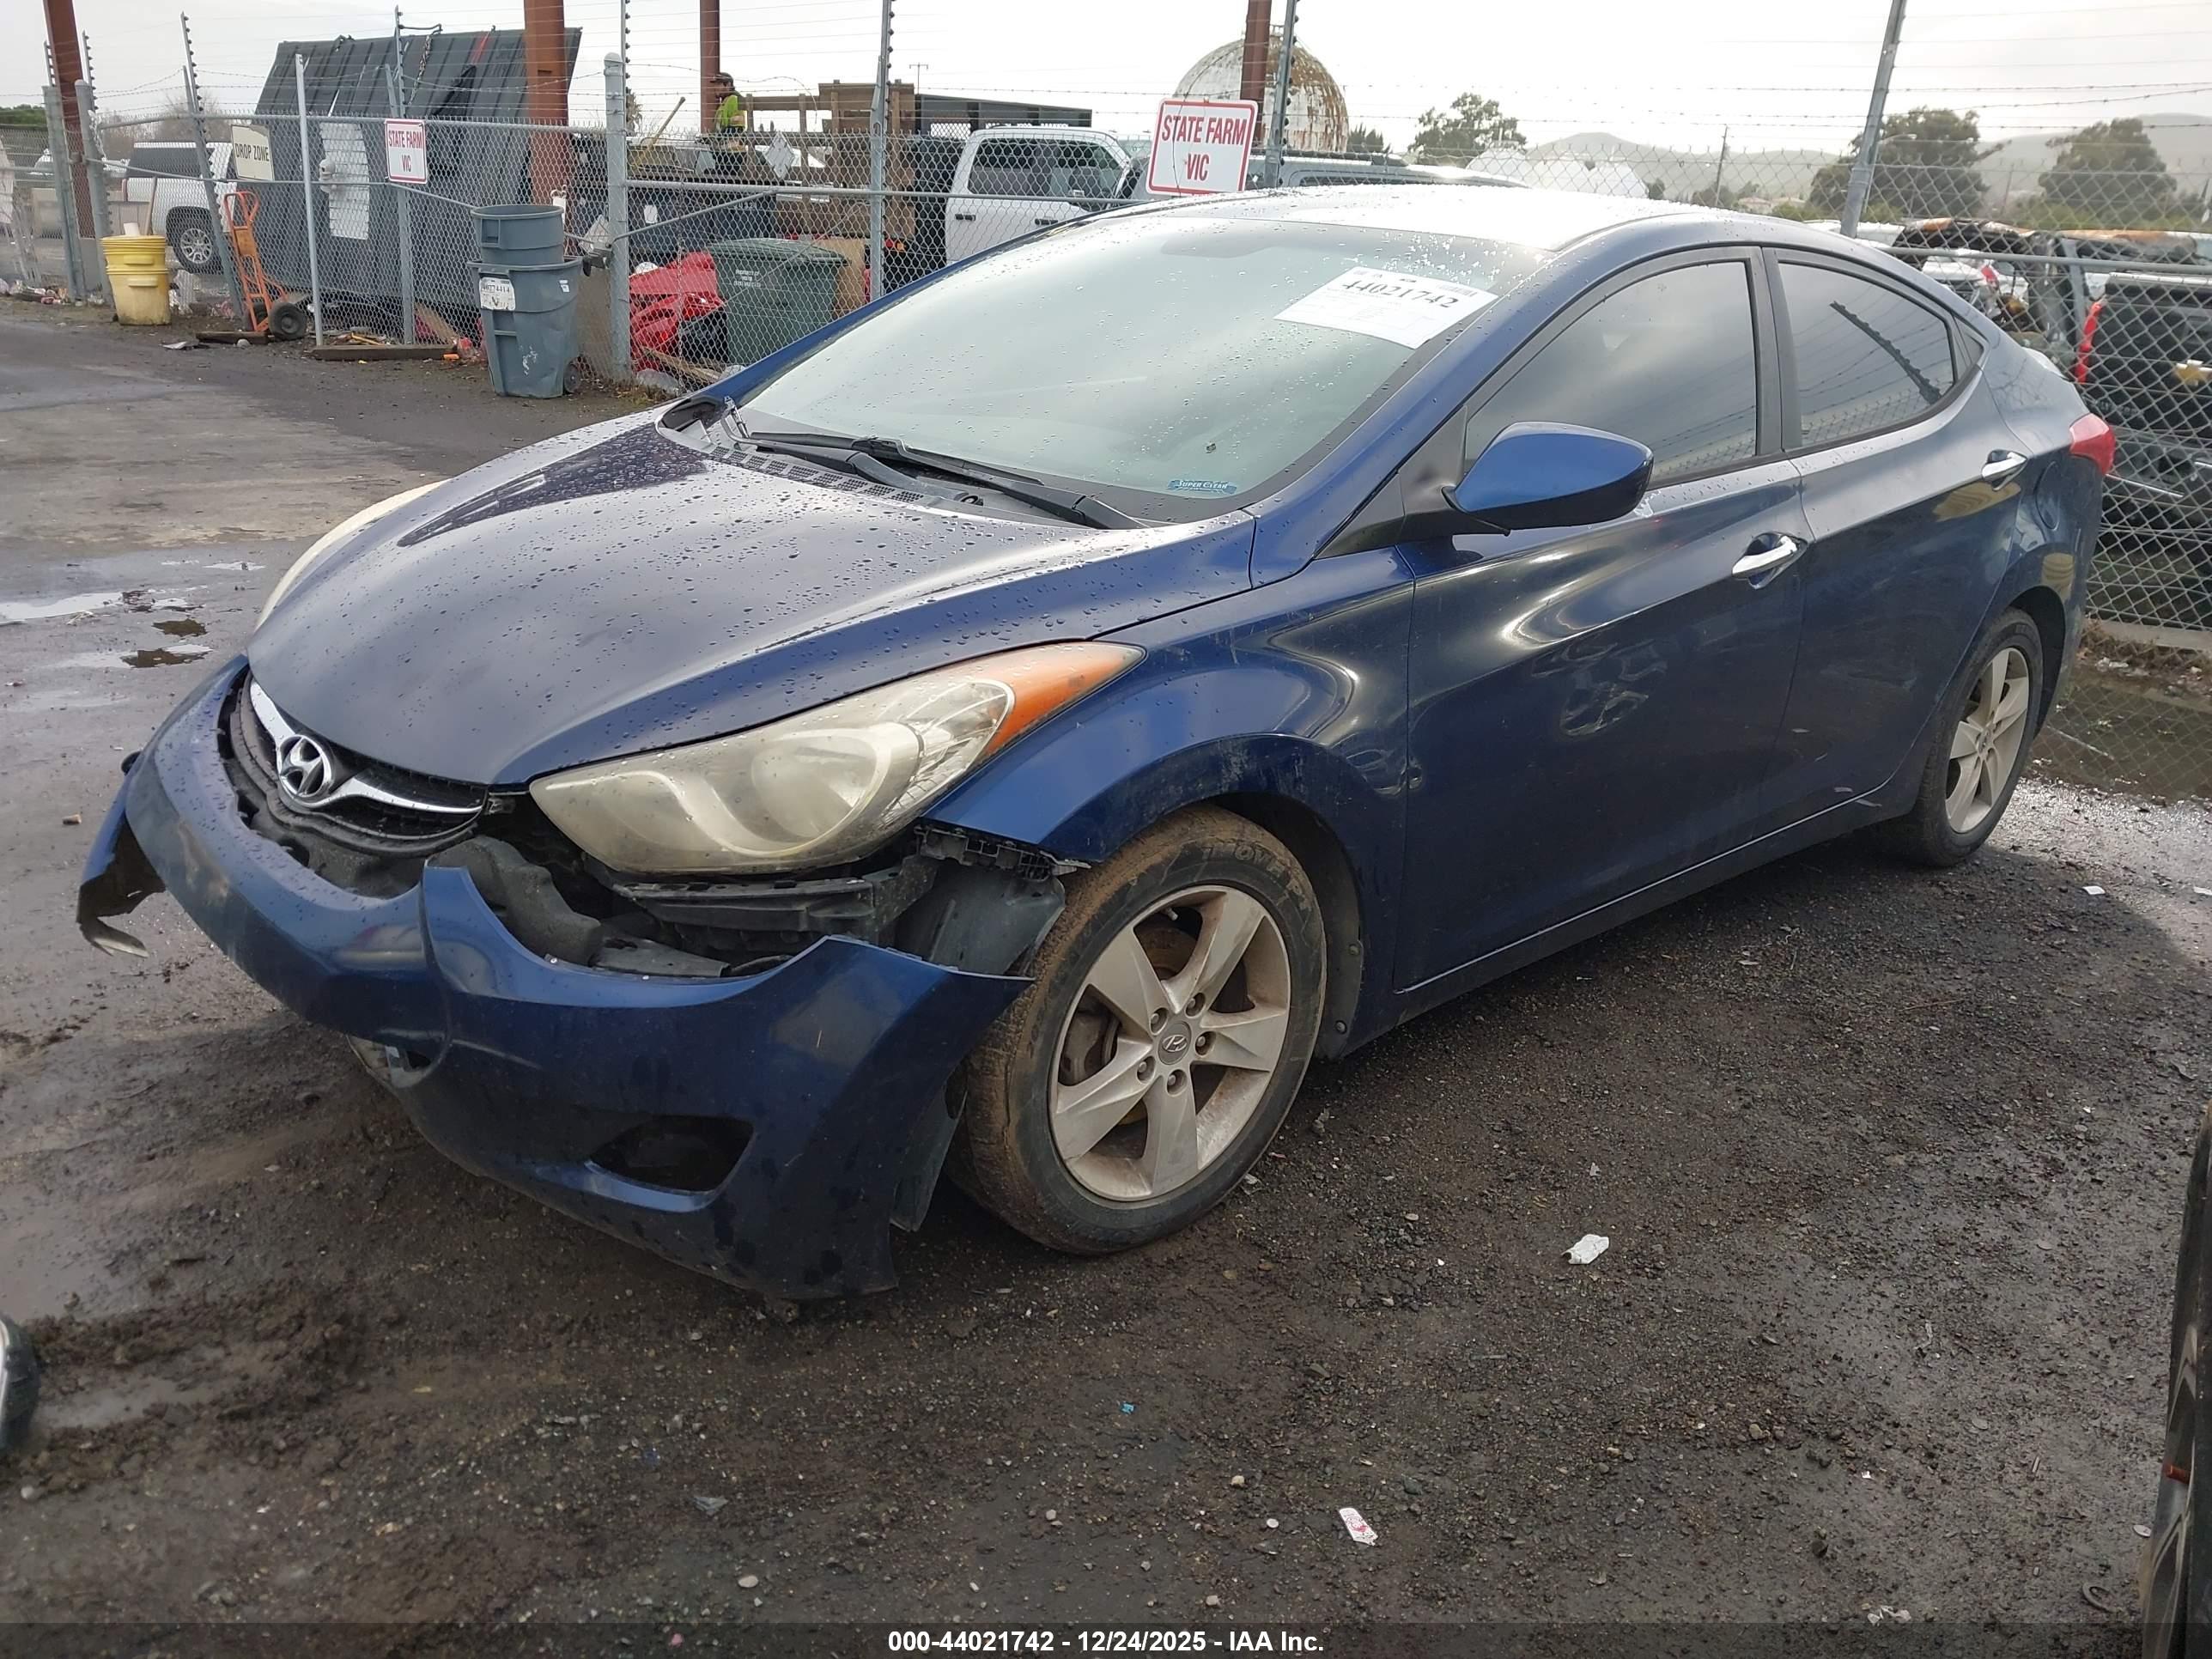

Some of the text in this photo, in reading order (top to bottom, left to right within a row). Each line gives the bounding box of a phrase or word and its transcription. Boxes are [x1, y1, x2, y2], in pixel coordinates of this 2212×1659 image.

[388, 130, 423, 149] STATE FARM
[1161, 114, 1248, 145] STATE FARM
[234, 143, 270, 161] DROP ZONE
[401, 154, 412, 173] VIC
[1186, 153, 1210, 181] VIC
[1342, 280, 1459, 308] 44021742
